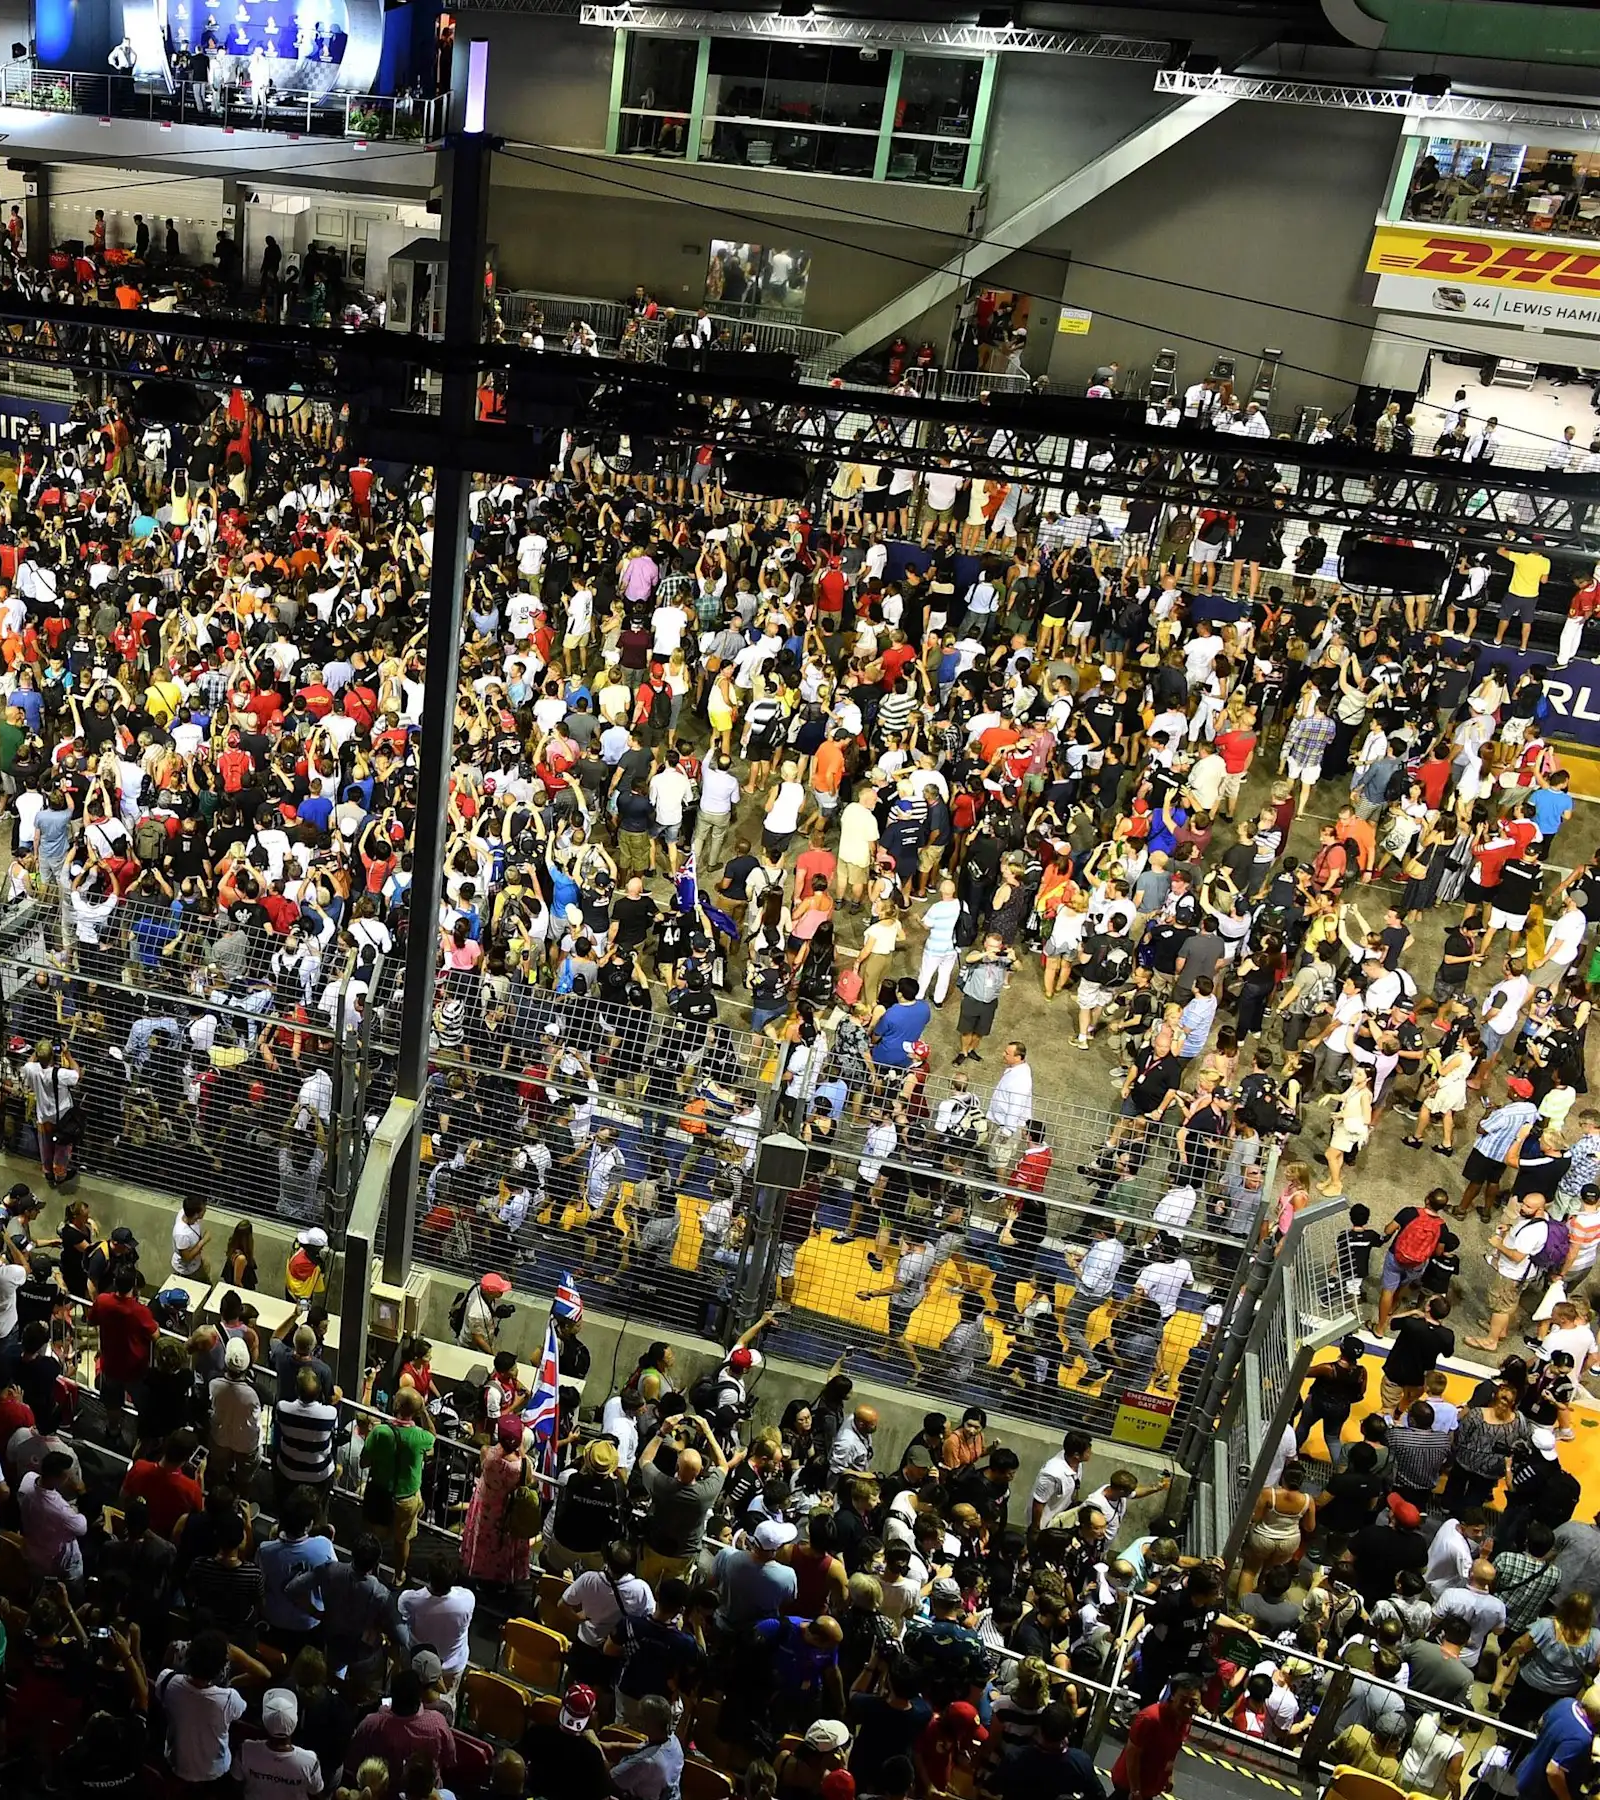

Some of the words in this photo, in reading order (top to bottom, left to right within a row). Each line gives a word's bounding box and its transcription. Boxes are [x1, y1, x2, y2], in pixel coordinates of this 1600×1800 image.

[29, 184, 34, 193] 3
[226, 207, 232, 216] 4
[1414, 238, 1600, 291] DHL
[1472, 297, 1490, 309] 44
[1503, 301, 1552, 317] LEWIS
[1126, 1392, 1172, 1407] EMERGENCY
[1137, 1401, 1157, 1410] GATE
[1123, 1415, 1136, 1423] PIT
[1137, 1419, 1162, 1429] ENTRY
